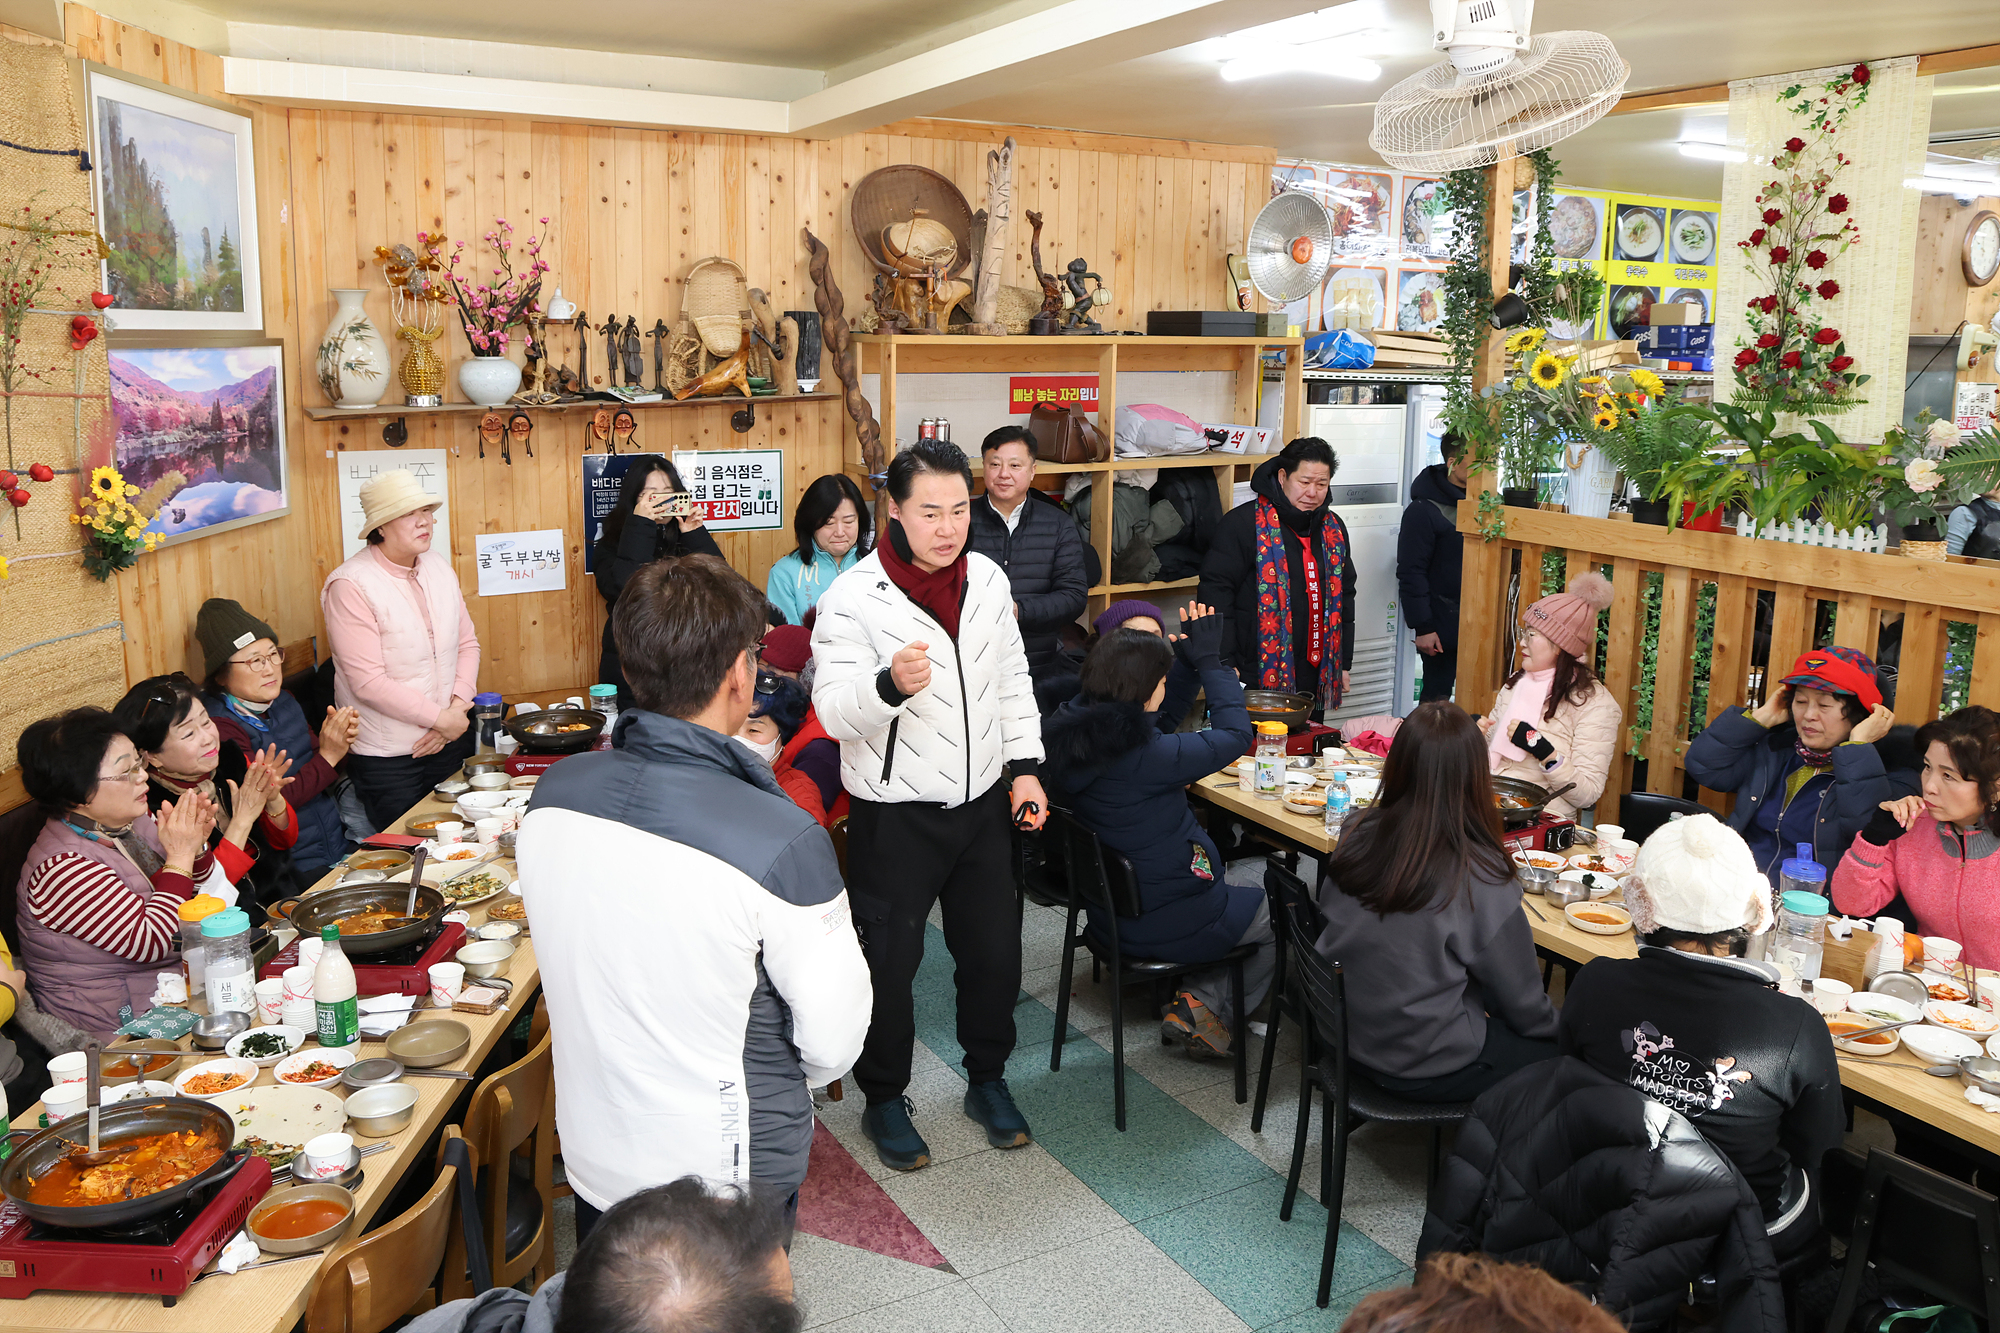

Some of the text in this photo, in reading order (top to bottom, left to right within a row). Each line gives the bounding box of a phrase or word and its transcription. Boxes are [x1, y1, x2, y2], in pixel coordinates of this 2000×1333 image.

[1626, 265, 1648, 278] 콩국수
[1674, 268, 1708, 281] 메밀콩국수
[1013, 387, 1099, 402] 배낭 놓는 자리입니
[711, 463, 763, 480] 음식점은
[712, 483, 751, 499] 담그는
[712, 500, 778, 518] 김치입니다
[479, 553, 492, 569] 굴
[1307, 561, 1315, 578] 새해
[505, 569, 534, 580] 개시
[1309, 581, 1318, 592] 복
[1311, 593, 1319, 610] 많이
[221, 981, 233, 1003] 새로
[1657, 1054, 1673, 1071] M
[1640, 1061, 1706, 1091] SPORTS
[1633, 1074, 1708, 1109] MADE FOR
[719, 1079, 739, 1142] ALPINE
